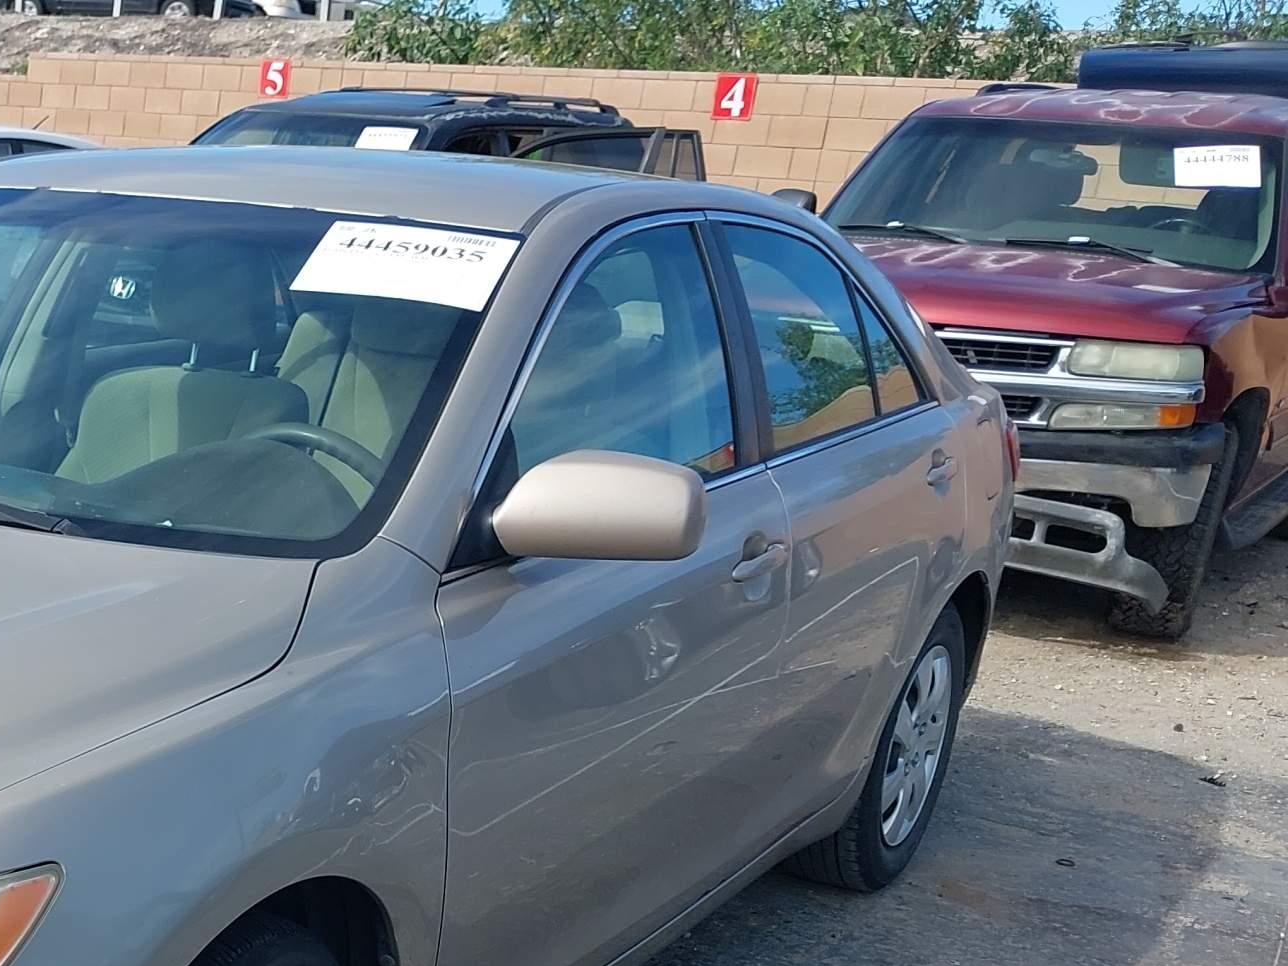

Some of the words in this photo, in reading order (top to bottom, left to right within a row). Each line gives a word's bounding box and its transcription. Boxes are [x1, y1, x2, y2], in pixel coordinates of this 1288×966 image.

[264, 62, 285, 95] 5
[720, 77, 746, 117] 4
[338, 236, 488, 263] 44459035
